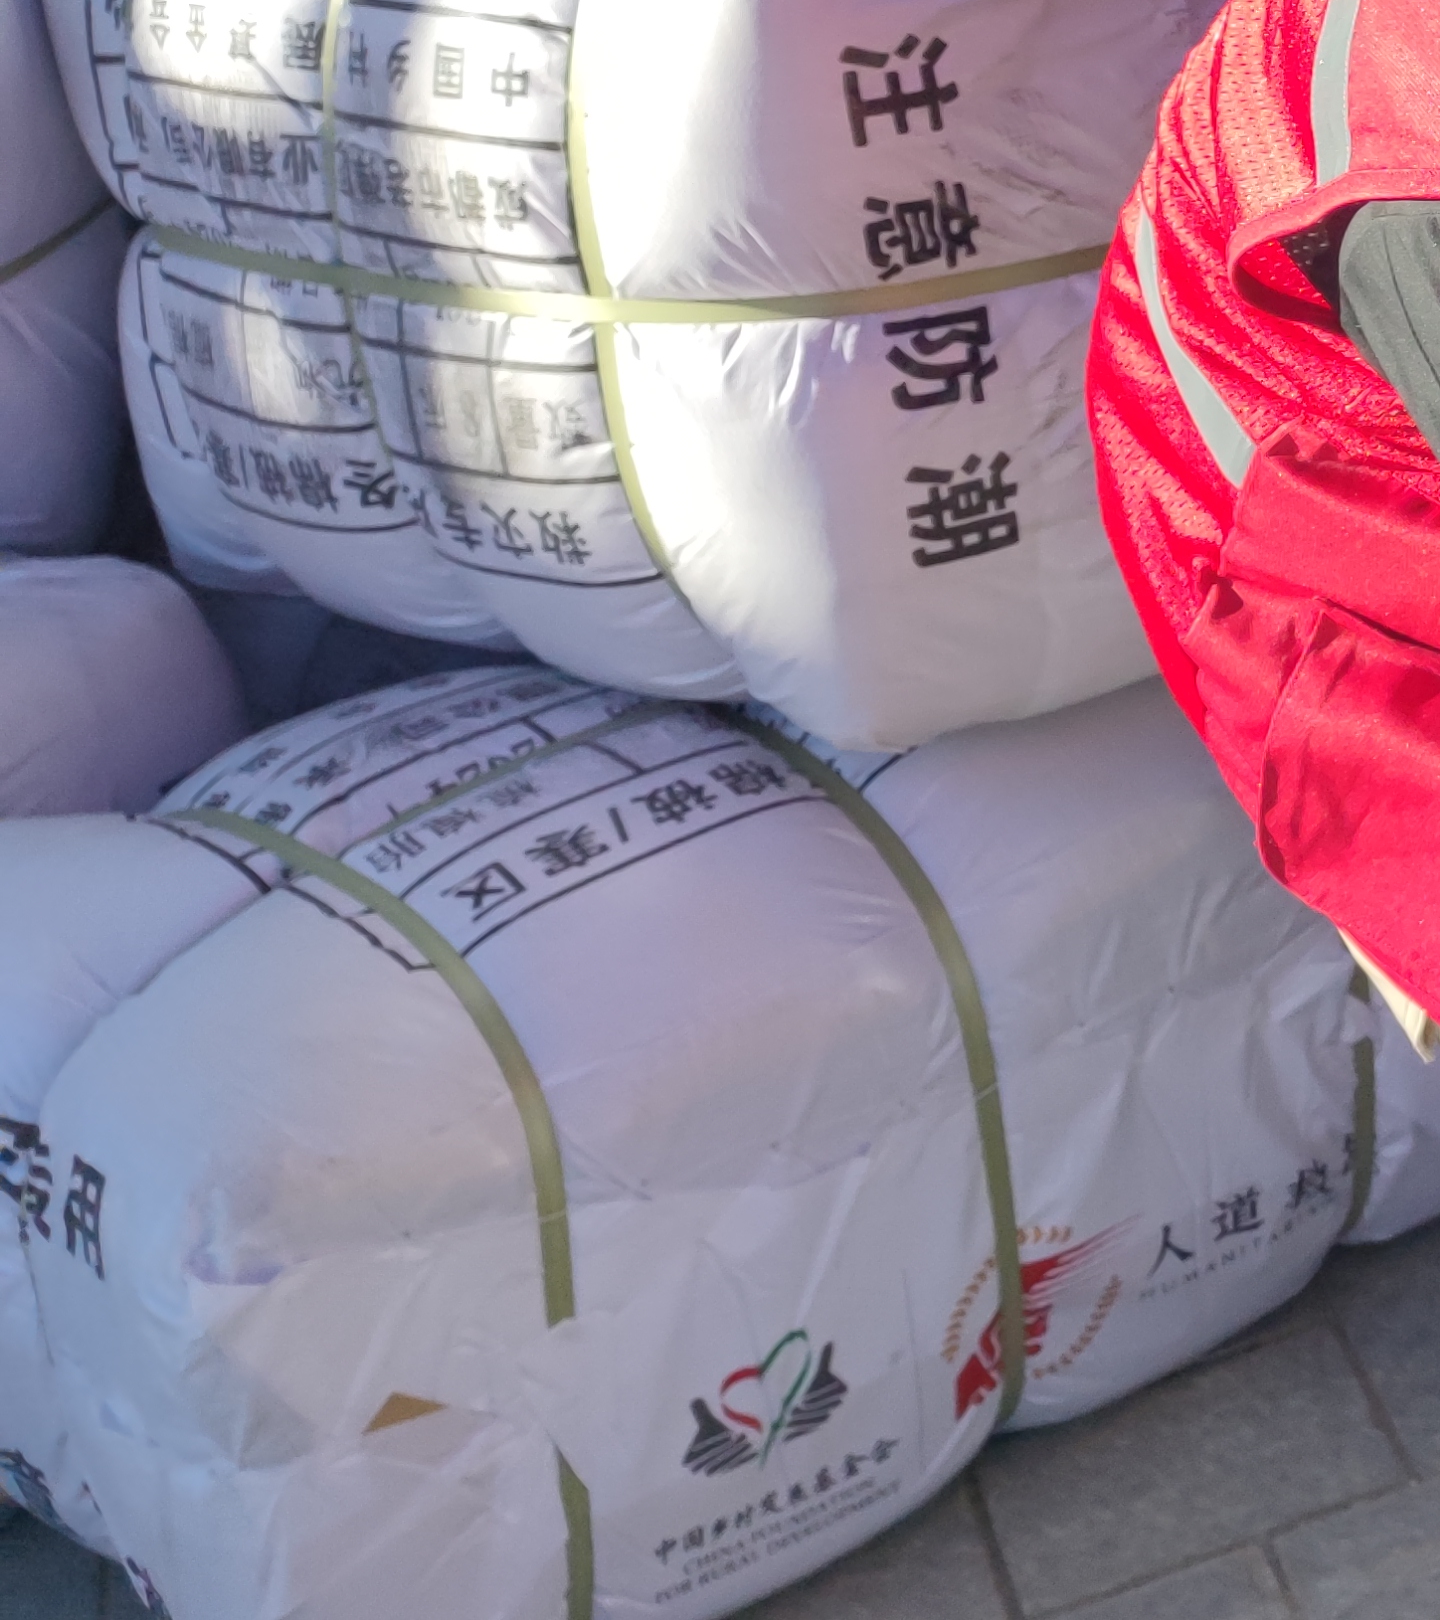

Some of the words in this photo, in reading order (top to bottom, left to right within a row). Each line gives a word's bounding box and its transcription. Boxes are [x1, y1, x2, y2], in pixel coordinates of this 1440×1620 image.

[838, 33, 1021, 570] 注意防潮
[654, 1437, 899, 1566] 中国乡村发展基金会
